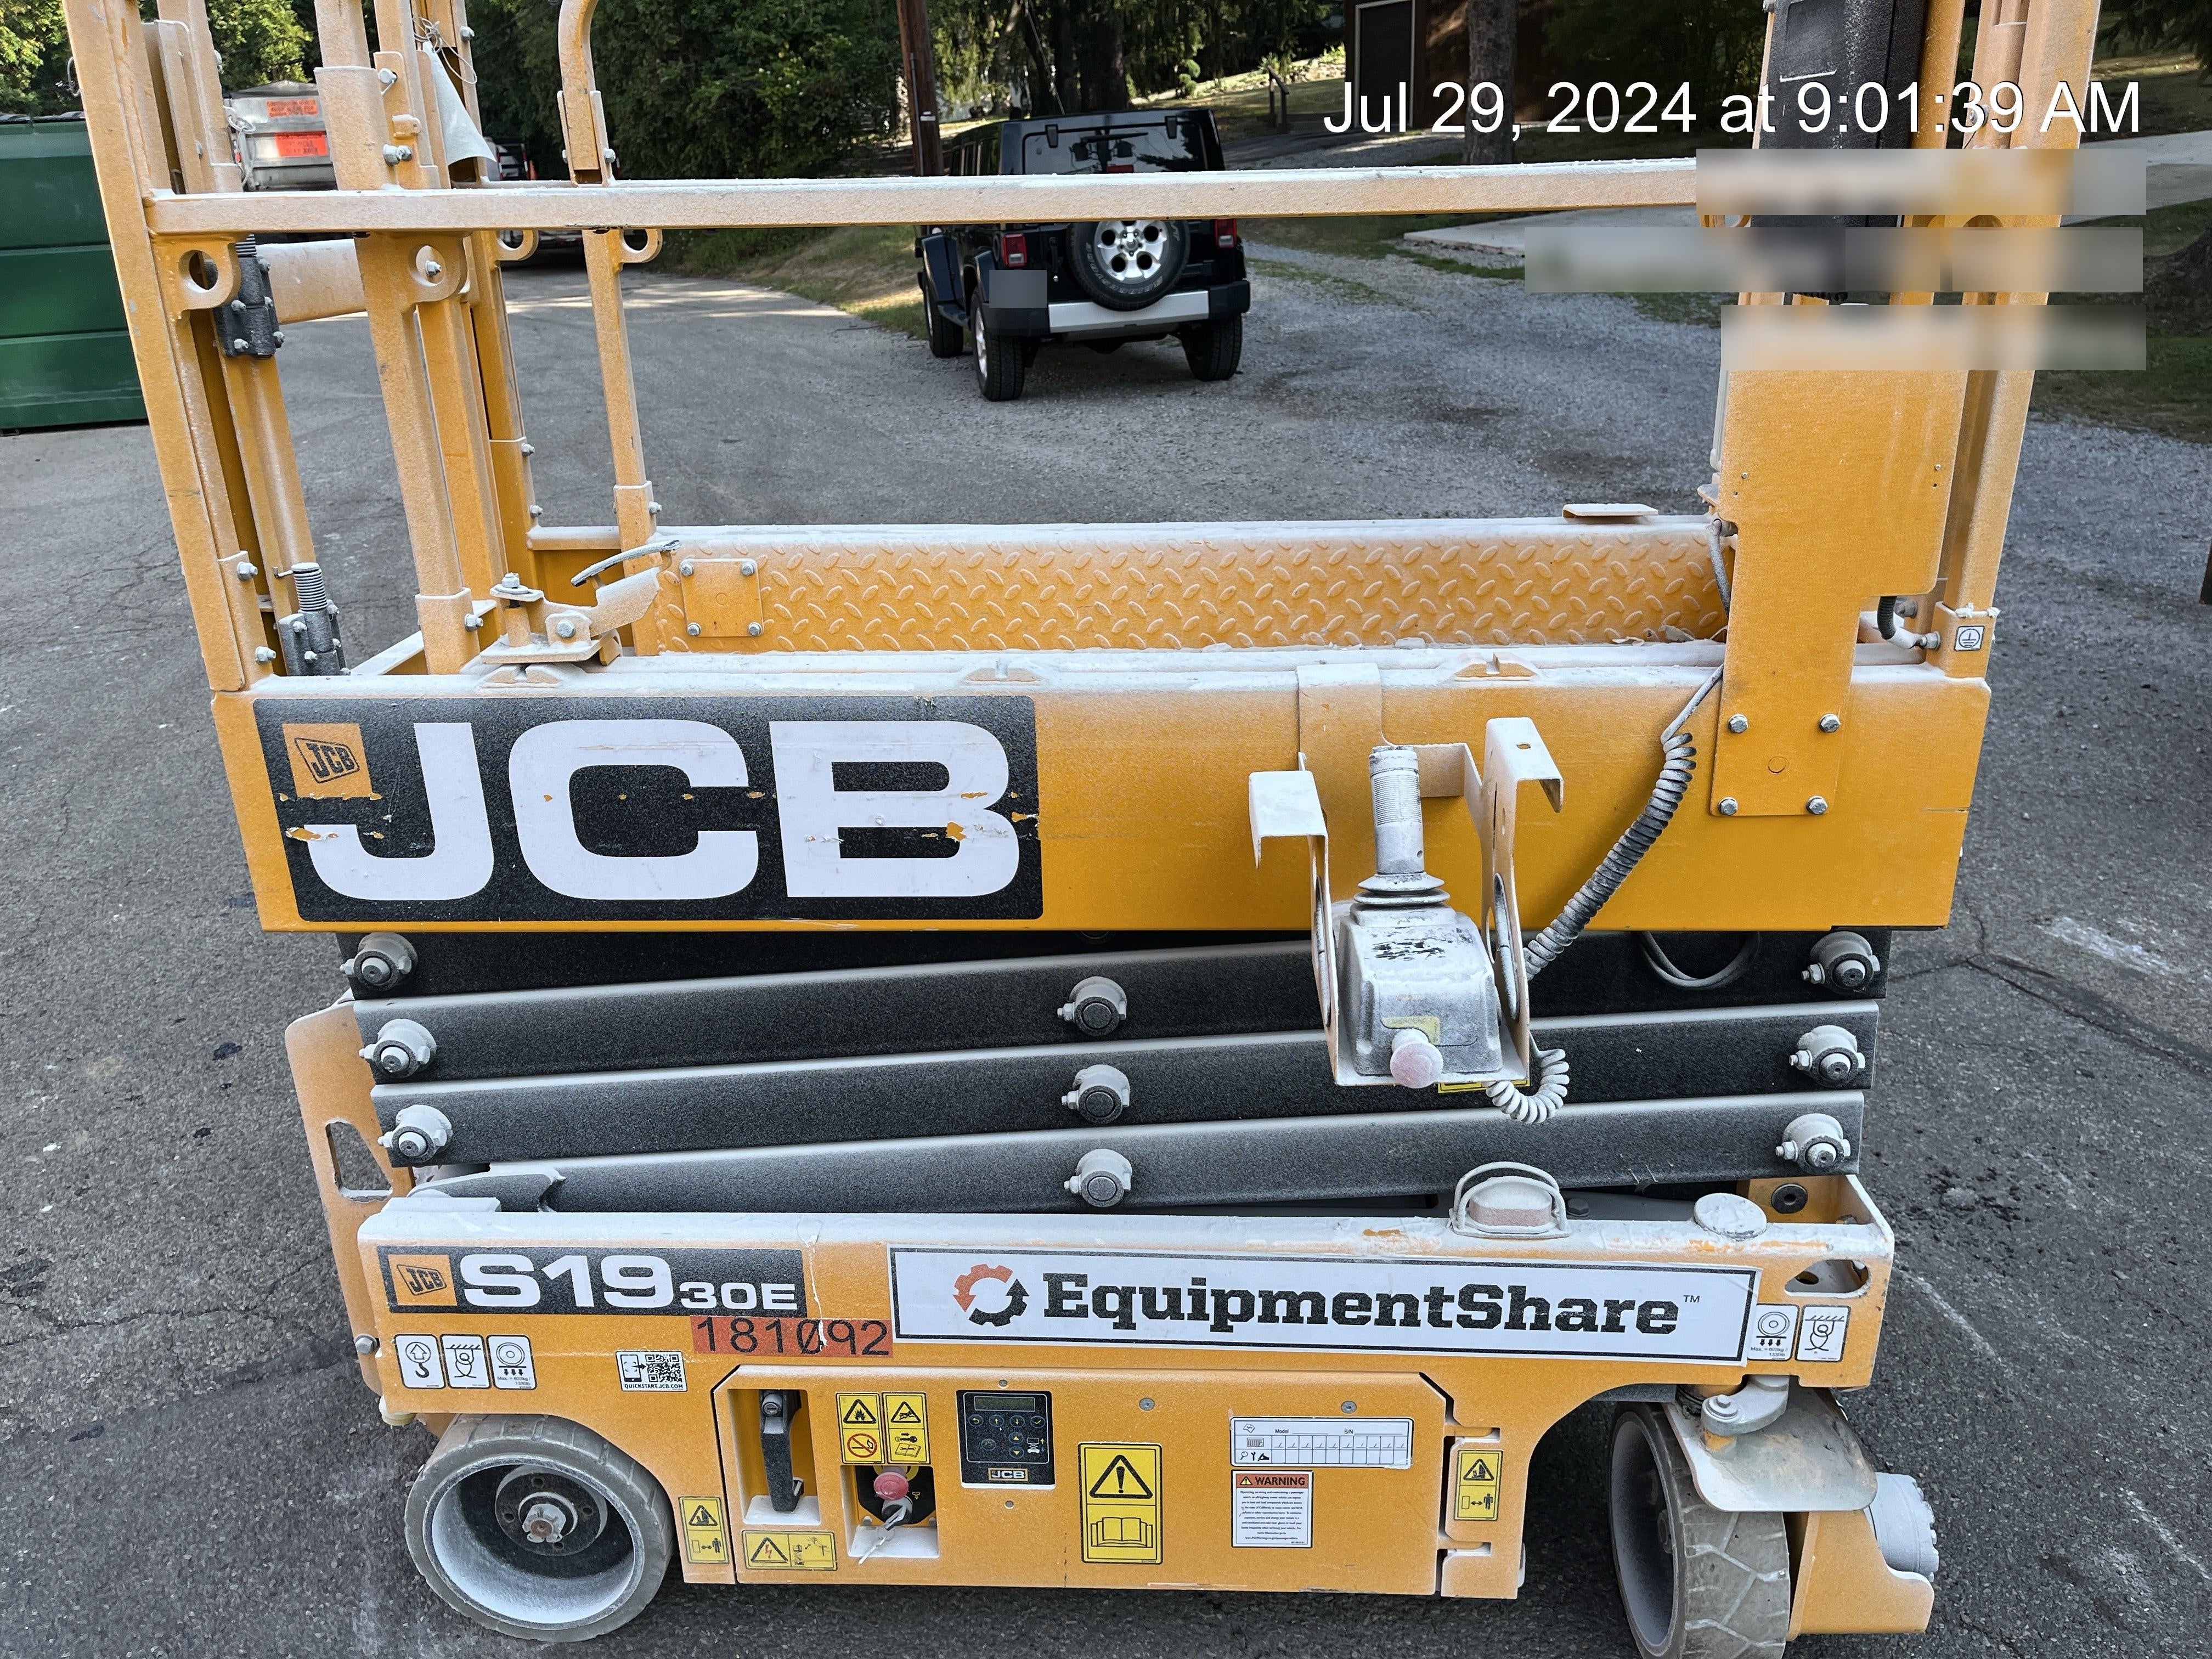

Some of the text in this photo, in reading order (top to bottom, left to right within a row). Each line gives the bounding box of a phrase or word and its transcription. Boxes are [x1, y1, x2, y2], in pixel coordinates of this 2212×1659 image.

[306, 742, 355, 778] JCB
[296, 719, 1019, 901] JCB
[406, 1268, 444, 1293] JCB
[1042, 1272, 1679, 1334] EquipmentShare
[697, 1317, 889, 1355] 181092
[991, 1470, 1025, 1479] JCB
[1255, 1476, 1305, 1486] WARNING
